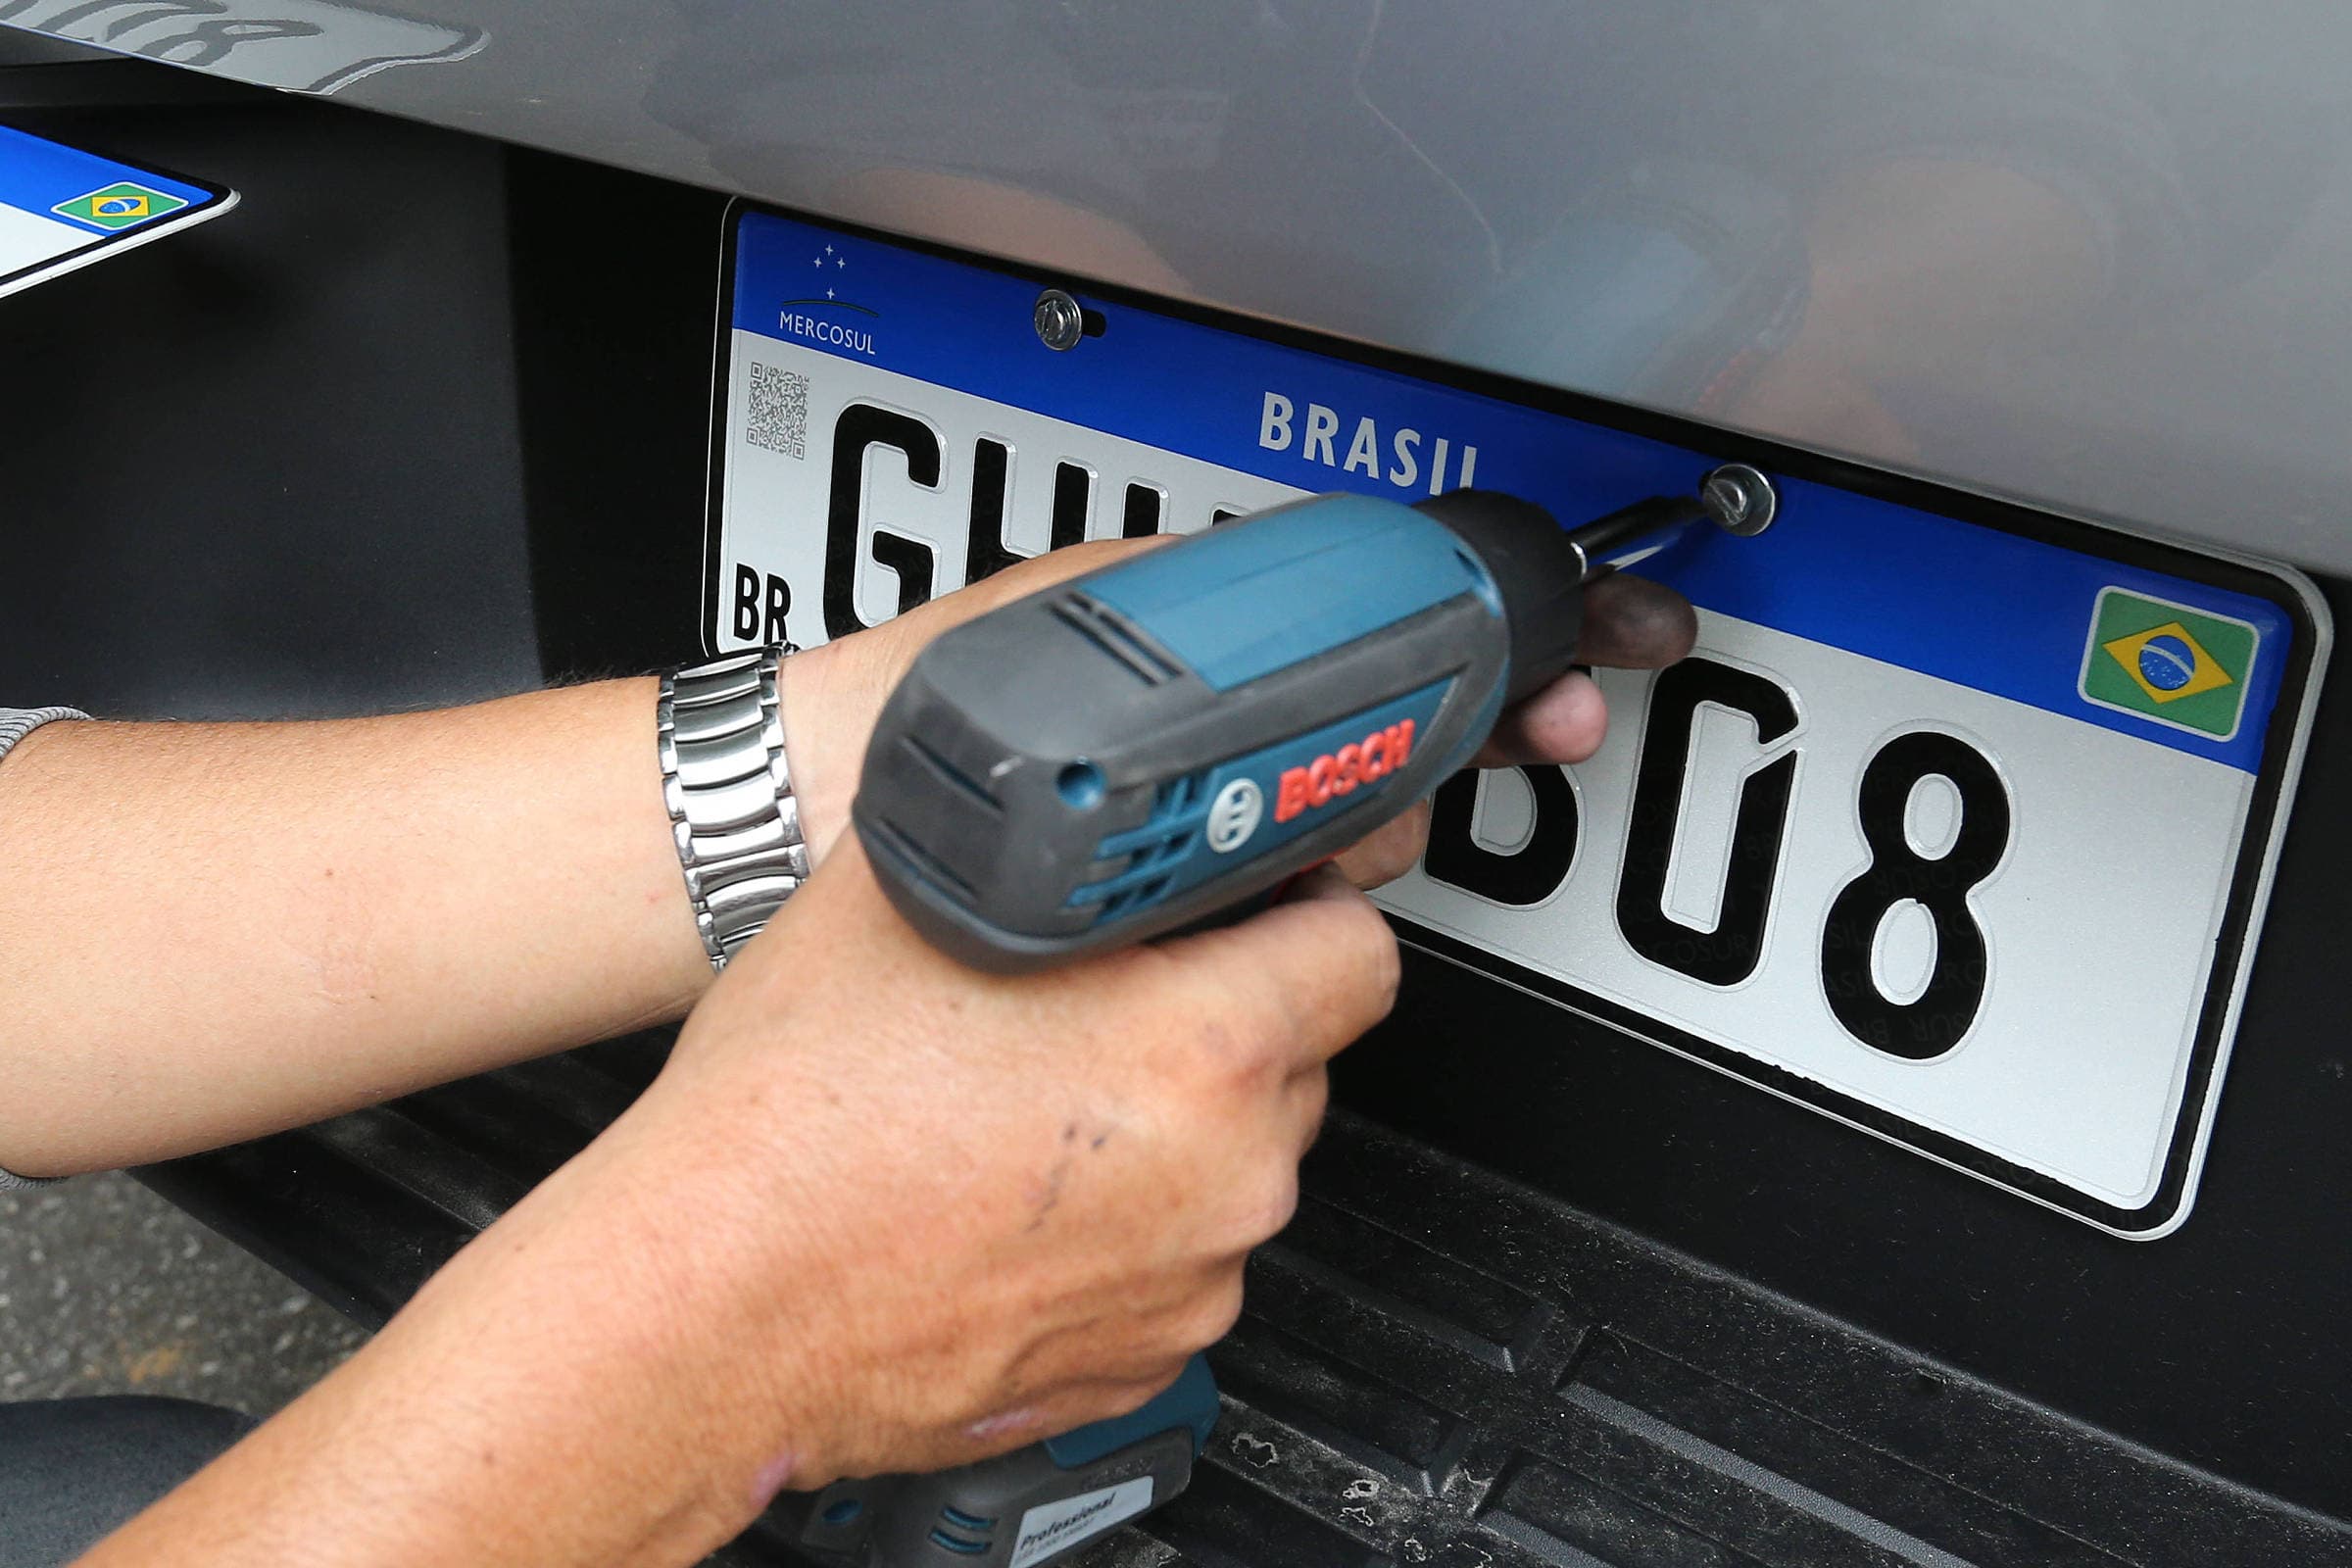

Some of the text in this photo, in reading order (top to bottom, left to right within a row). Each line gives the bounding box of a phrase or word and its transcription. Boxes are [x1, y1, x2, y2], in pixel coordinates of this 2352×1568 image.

[779, 311, 876, 355] MERCOSUL
[733, 563, 792, 645] BR
[1275, 718, 1415, 823] BOSCH
[1020, 1491, 1117, 1549] Professional
